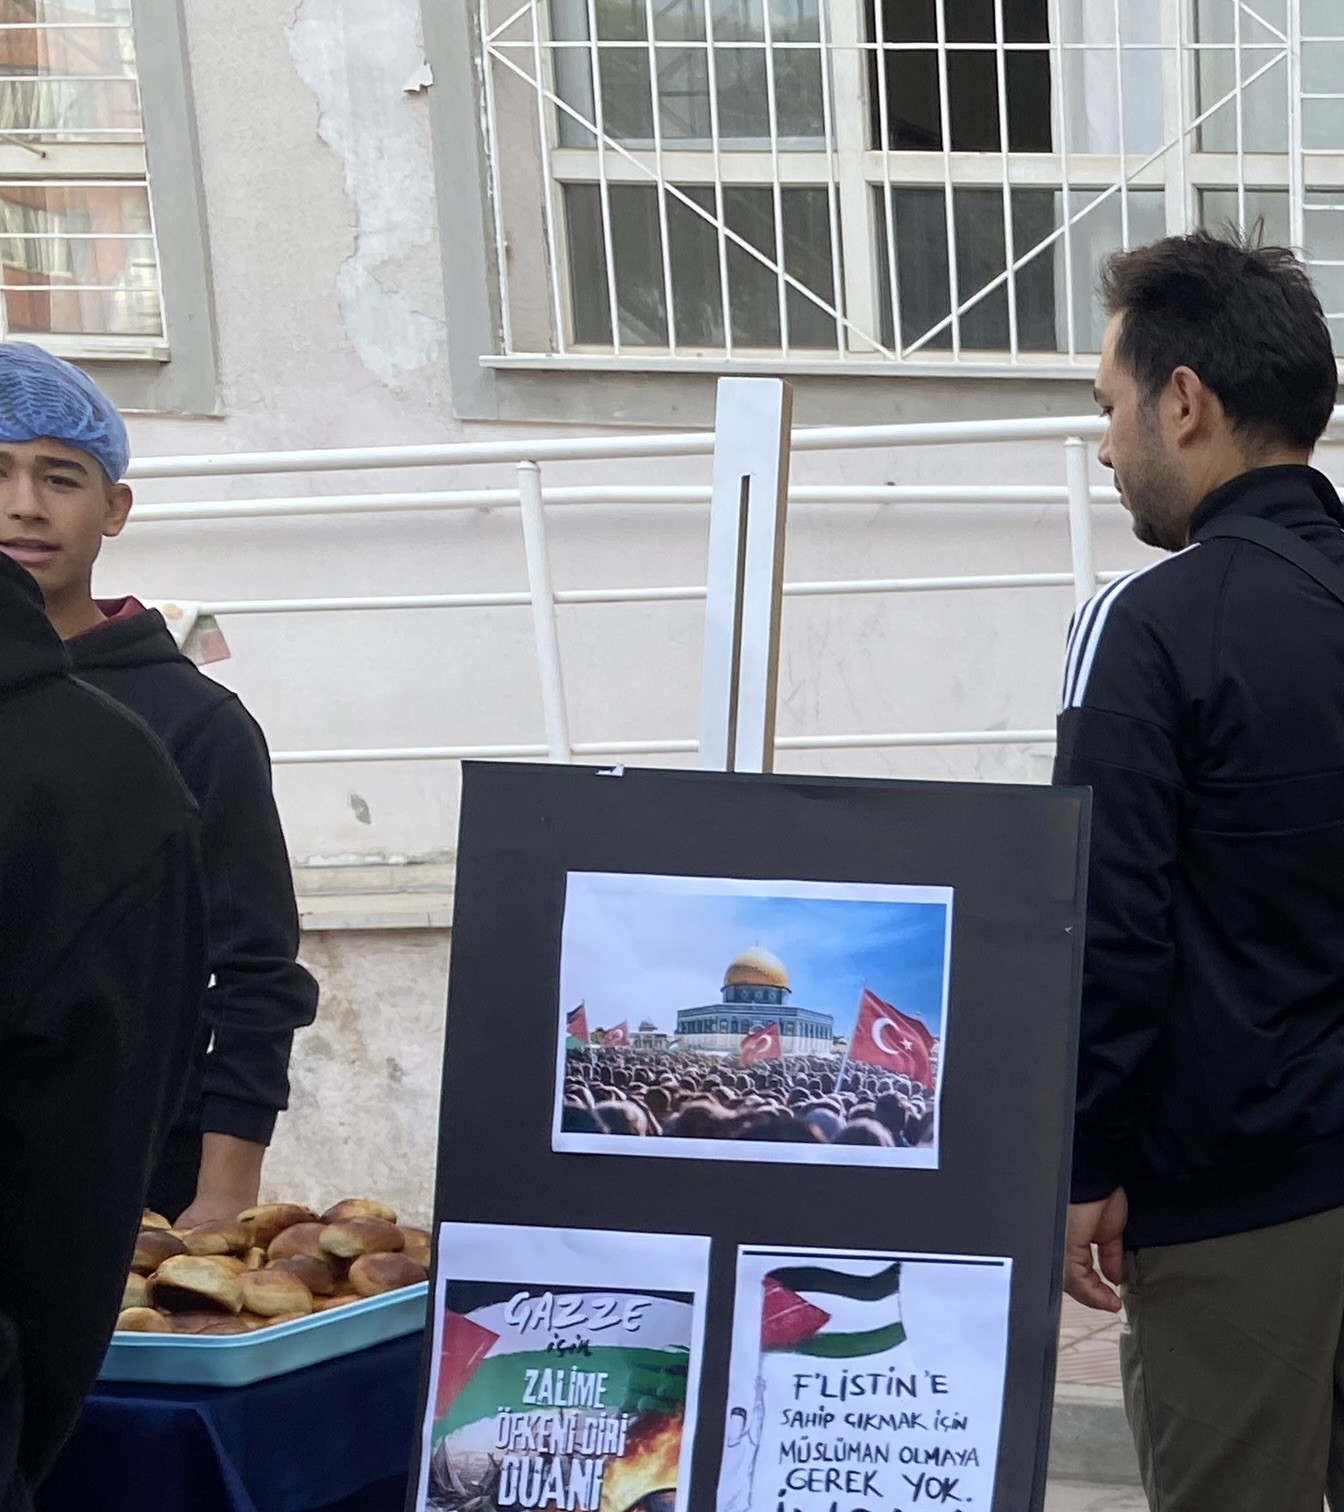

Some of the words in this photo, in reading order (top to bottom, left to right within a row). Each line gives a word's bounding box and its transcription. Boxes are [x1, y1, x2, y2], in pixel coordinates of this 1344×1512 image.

[503, 1291, 652, 1334] GAZZE
[521, 1365, 608, 1409] ZALİME
[780, 1404, 836, 1429] SAHİP
[843, 1411, 928, 1432] ÇIKMAK
[779, 1435, 890, 1465] MÜSLÜMAN
[898, 1445, 980, 1467] OLMAYA
[785, 1467, 884, 1498] GEREK
[902, 1472, 973, 1503] YOK.
